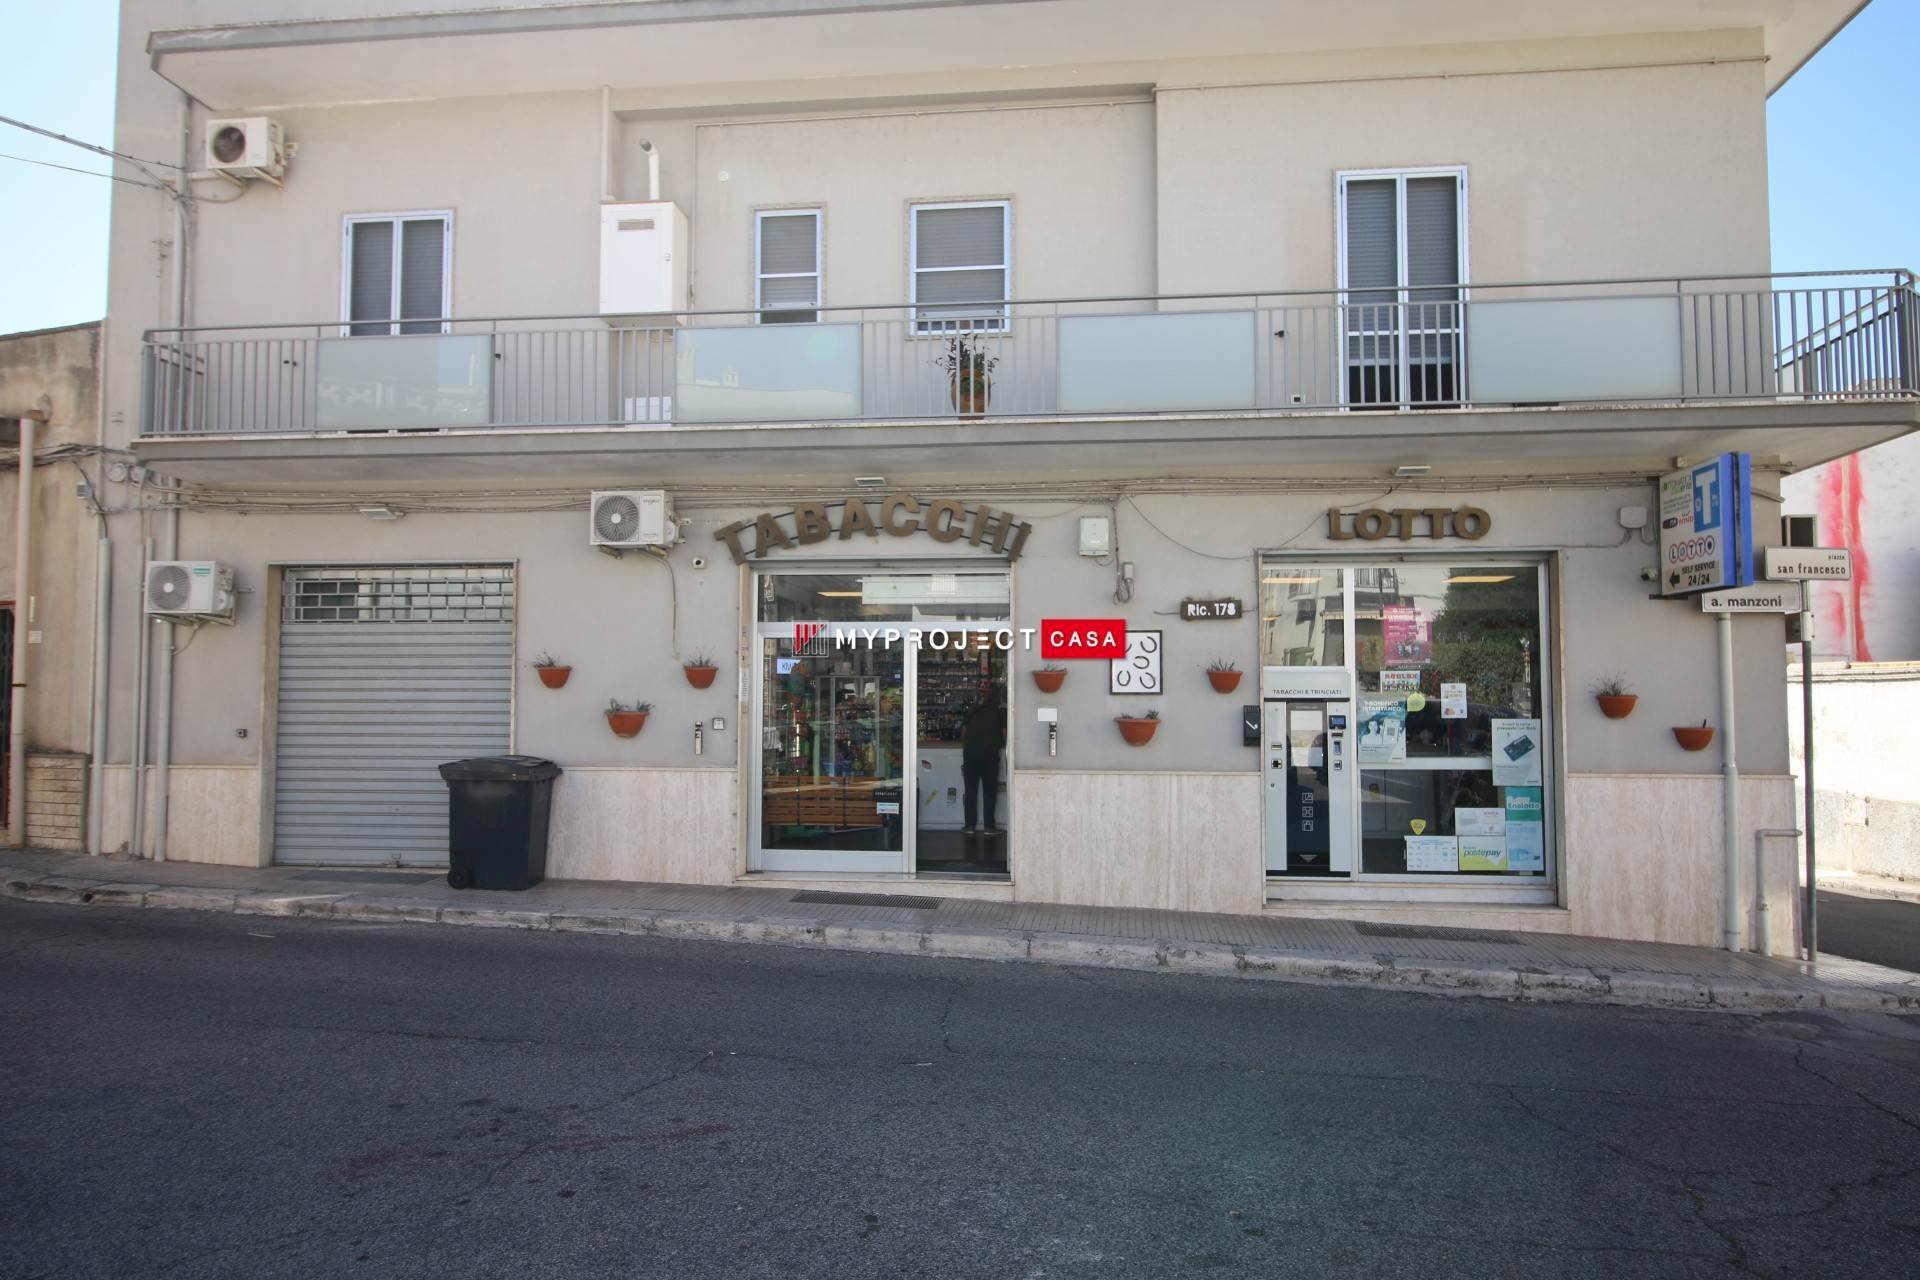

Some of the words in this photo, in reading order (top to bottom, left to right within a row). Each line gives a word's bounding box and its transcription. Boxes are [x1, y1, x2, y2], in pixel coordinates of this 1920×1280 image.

[714, 494, 1032, 565] TABACCHI
[1327, 507, 1491, 541] LOTTO
[1669, 536, 1715, 563] LOTTO
[1682, 565, 1694, 575] SELF
[1695, 560, 1715, 571] SERVICE
[1777, 565, 1794, 574] san
[1798, 563, 1846, 575] francesco
[1688, 573, 1710, 587] 24/24
[1711, 598, 1722, 607] a.
[1727, 596, 1782, 607] manzoni
[1187, 603, 1211, 617] Ric.
[1214, 602, 1236, 616] 178
